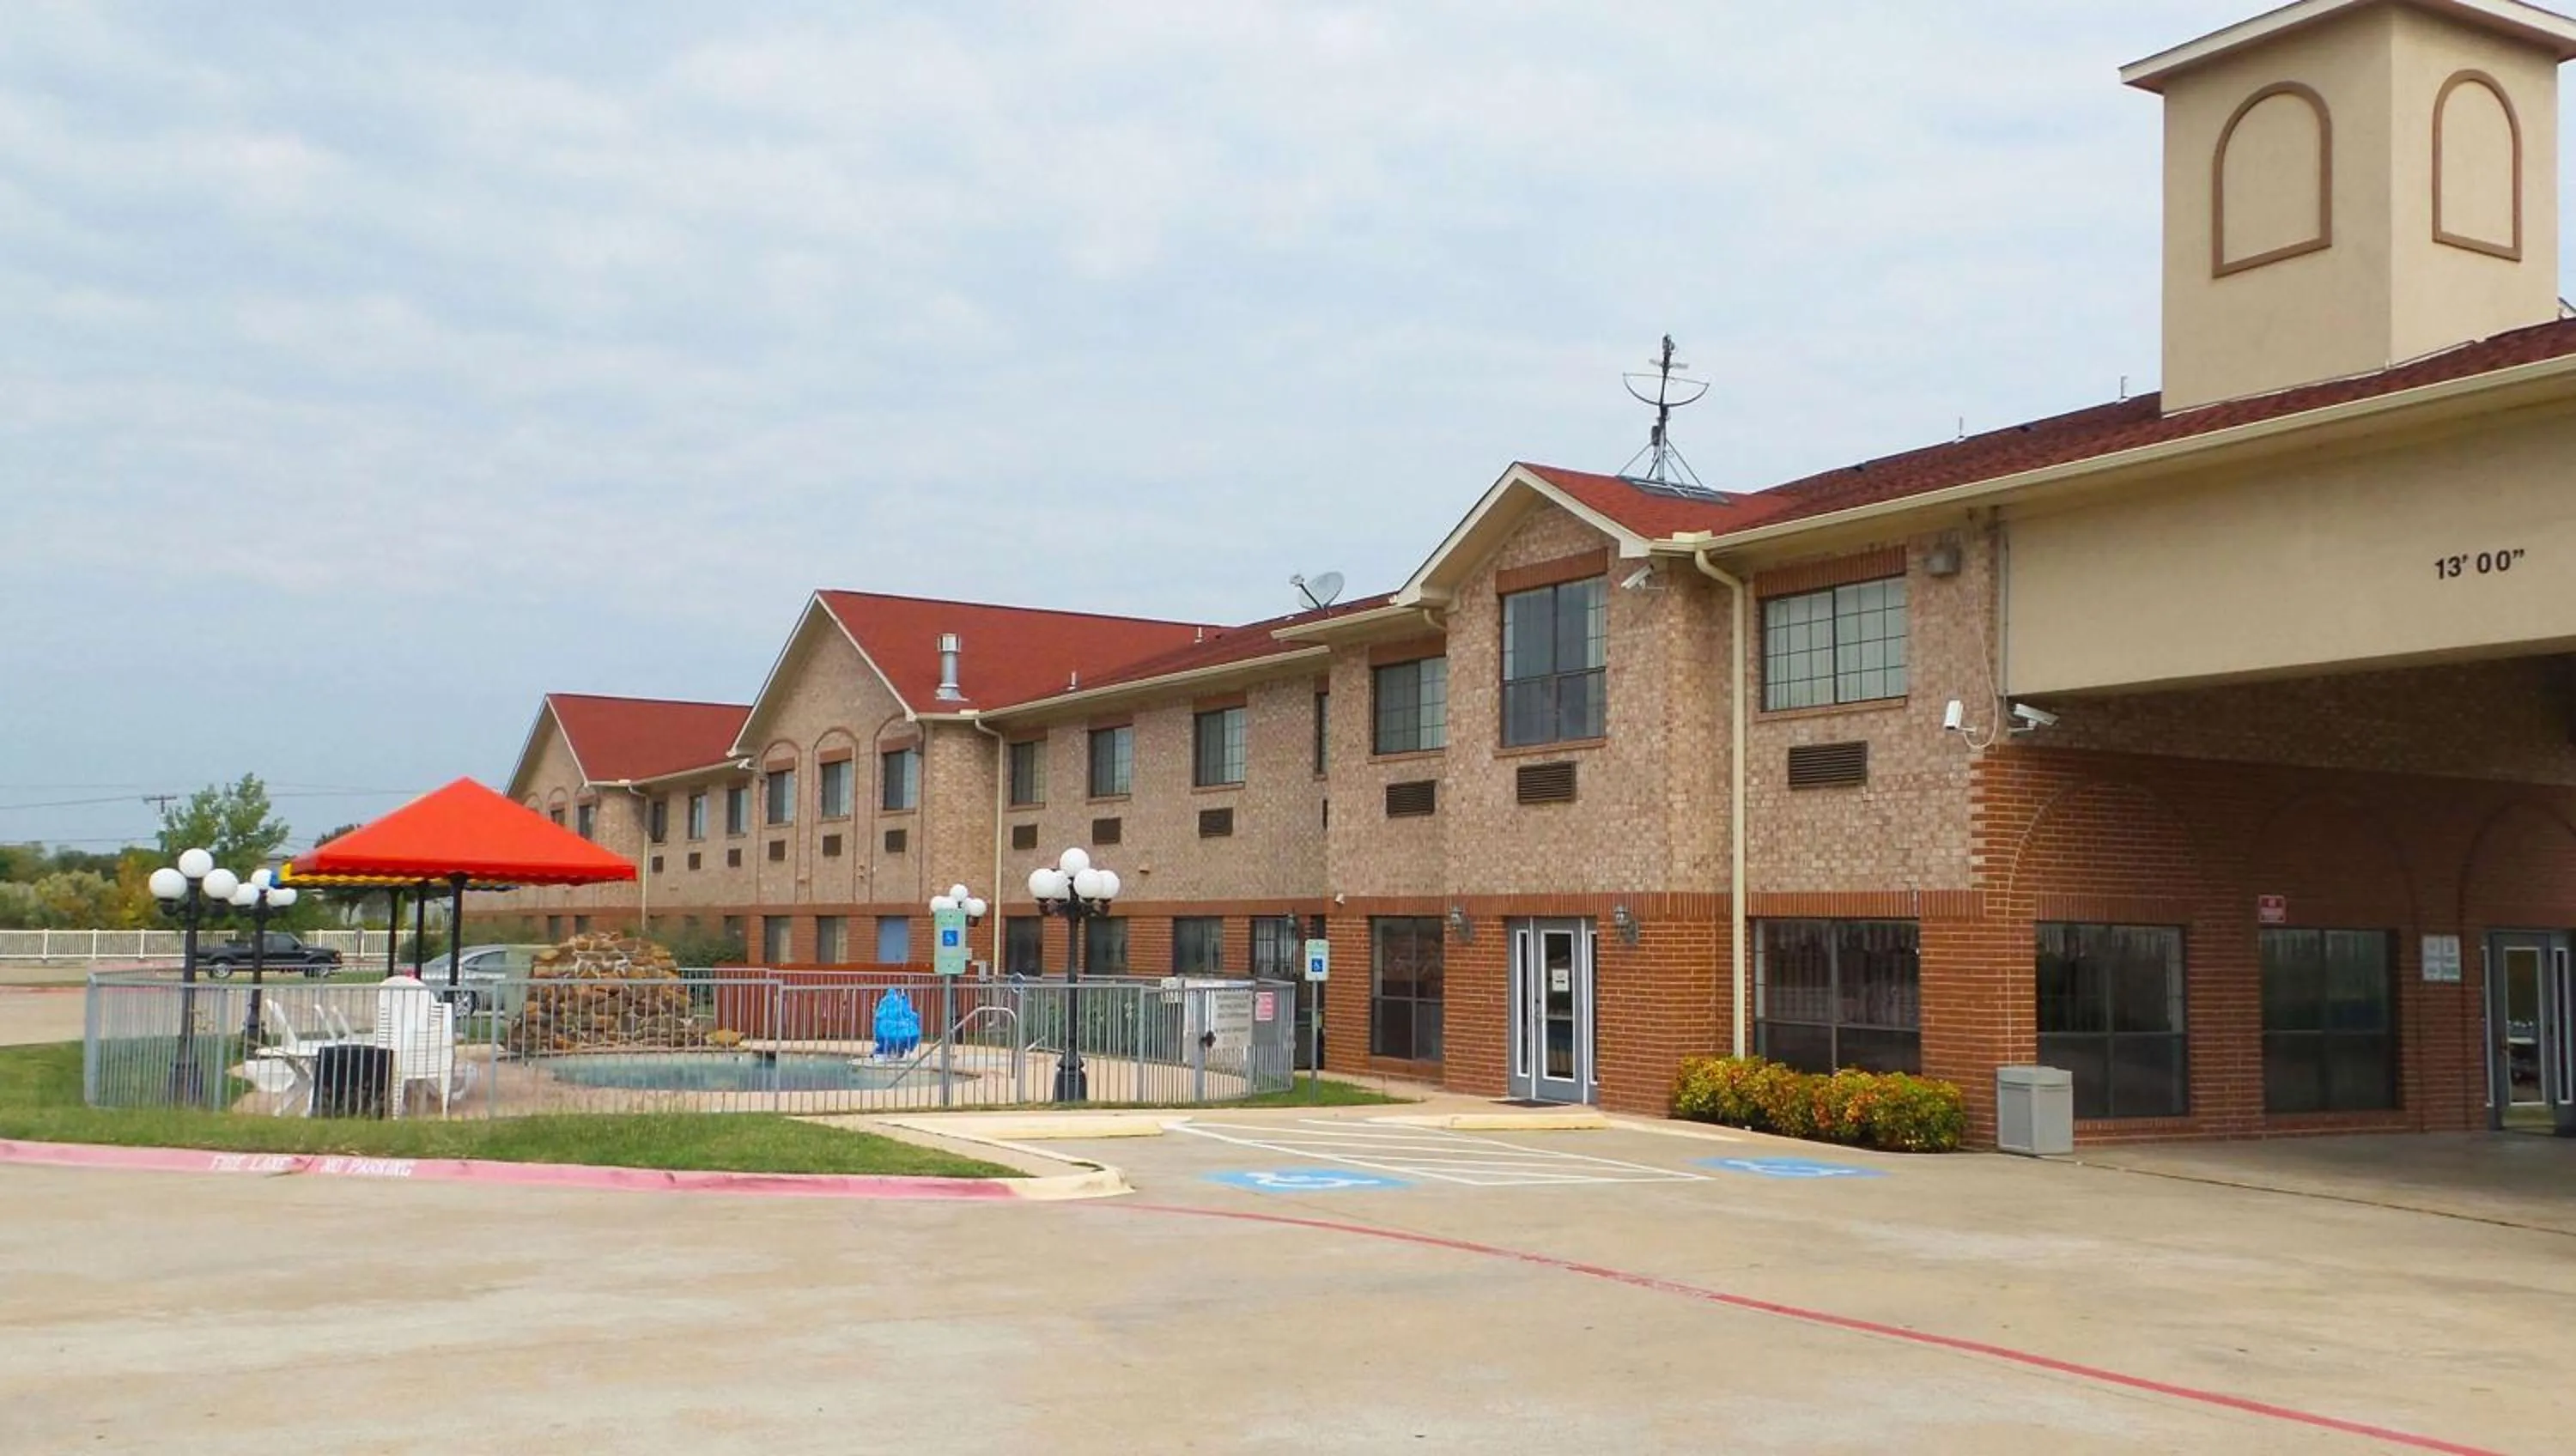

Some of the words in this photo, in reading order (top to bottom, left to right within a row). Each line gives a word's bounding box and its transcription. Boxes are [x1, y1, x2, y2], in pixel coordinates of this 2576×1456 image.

[209, 1155, 246, 1172] FIRE
[319, 1157, 345, 1175] NO
[346, 1158, 416, 1177] PARKING
